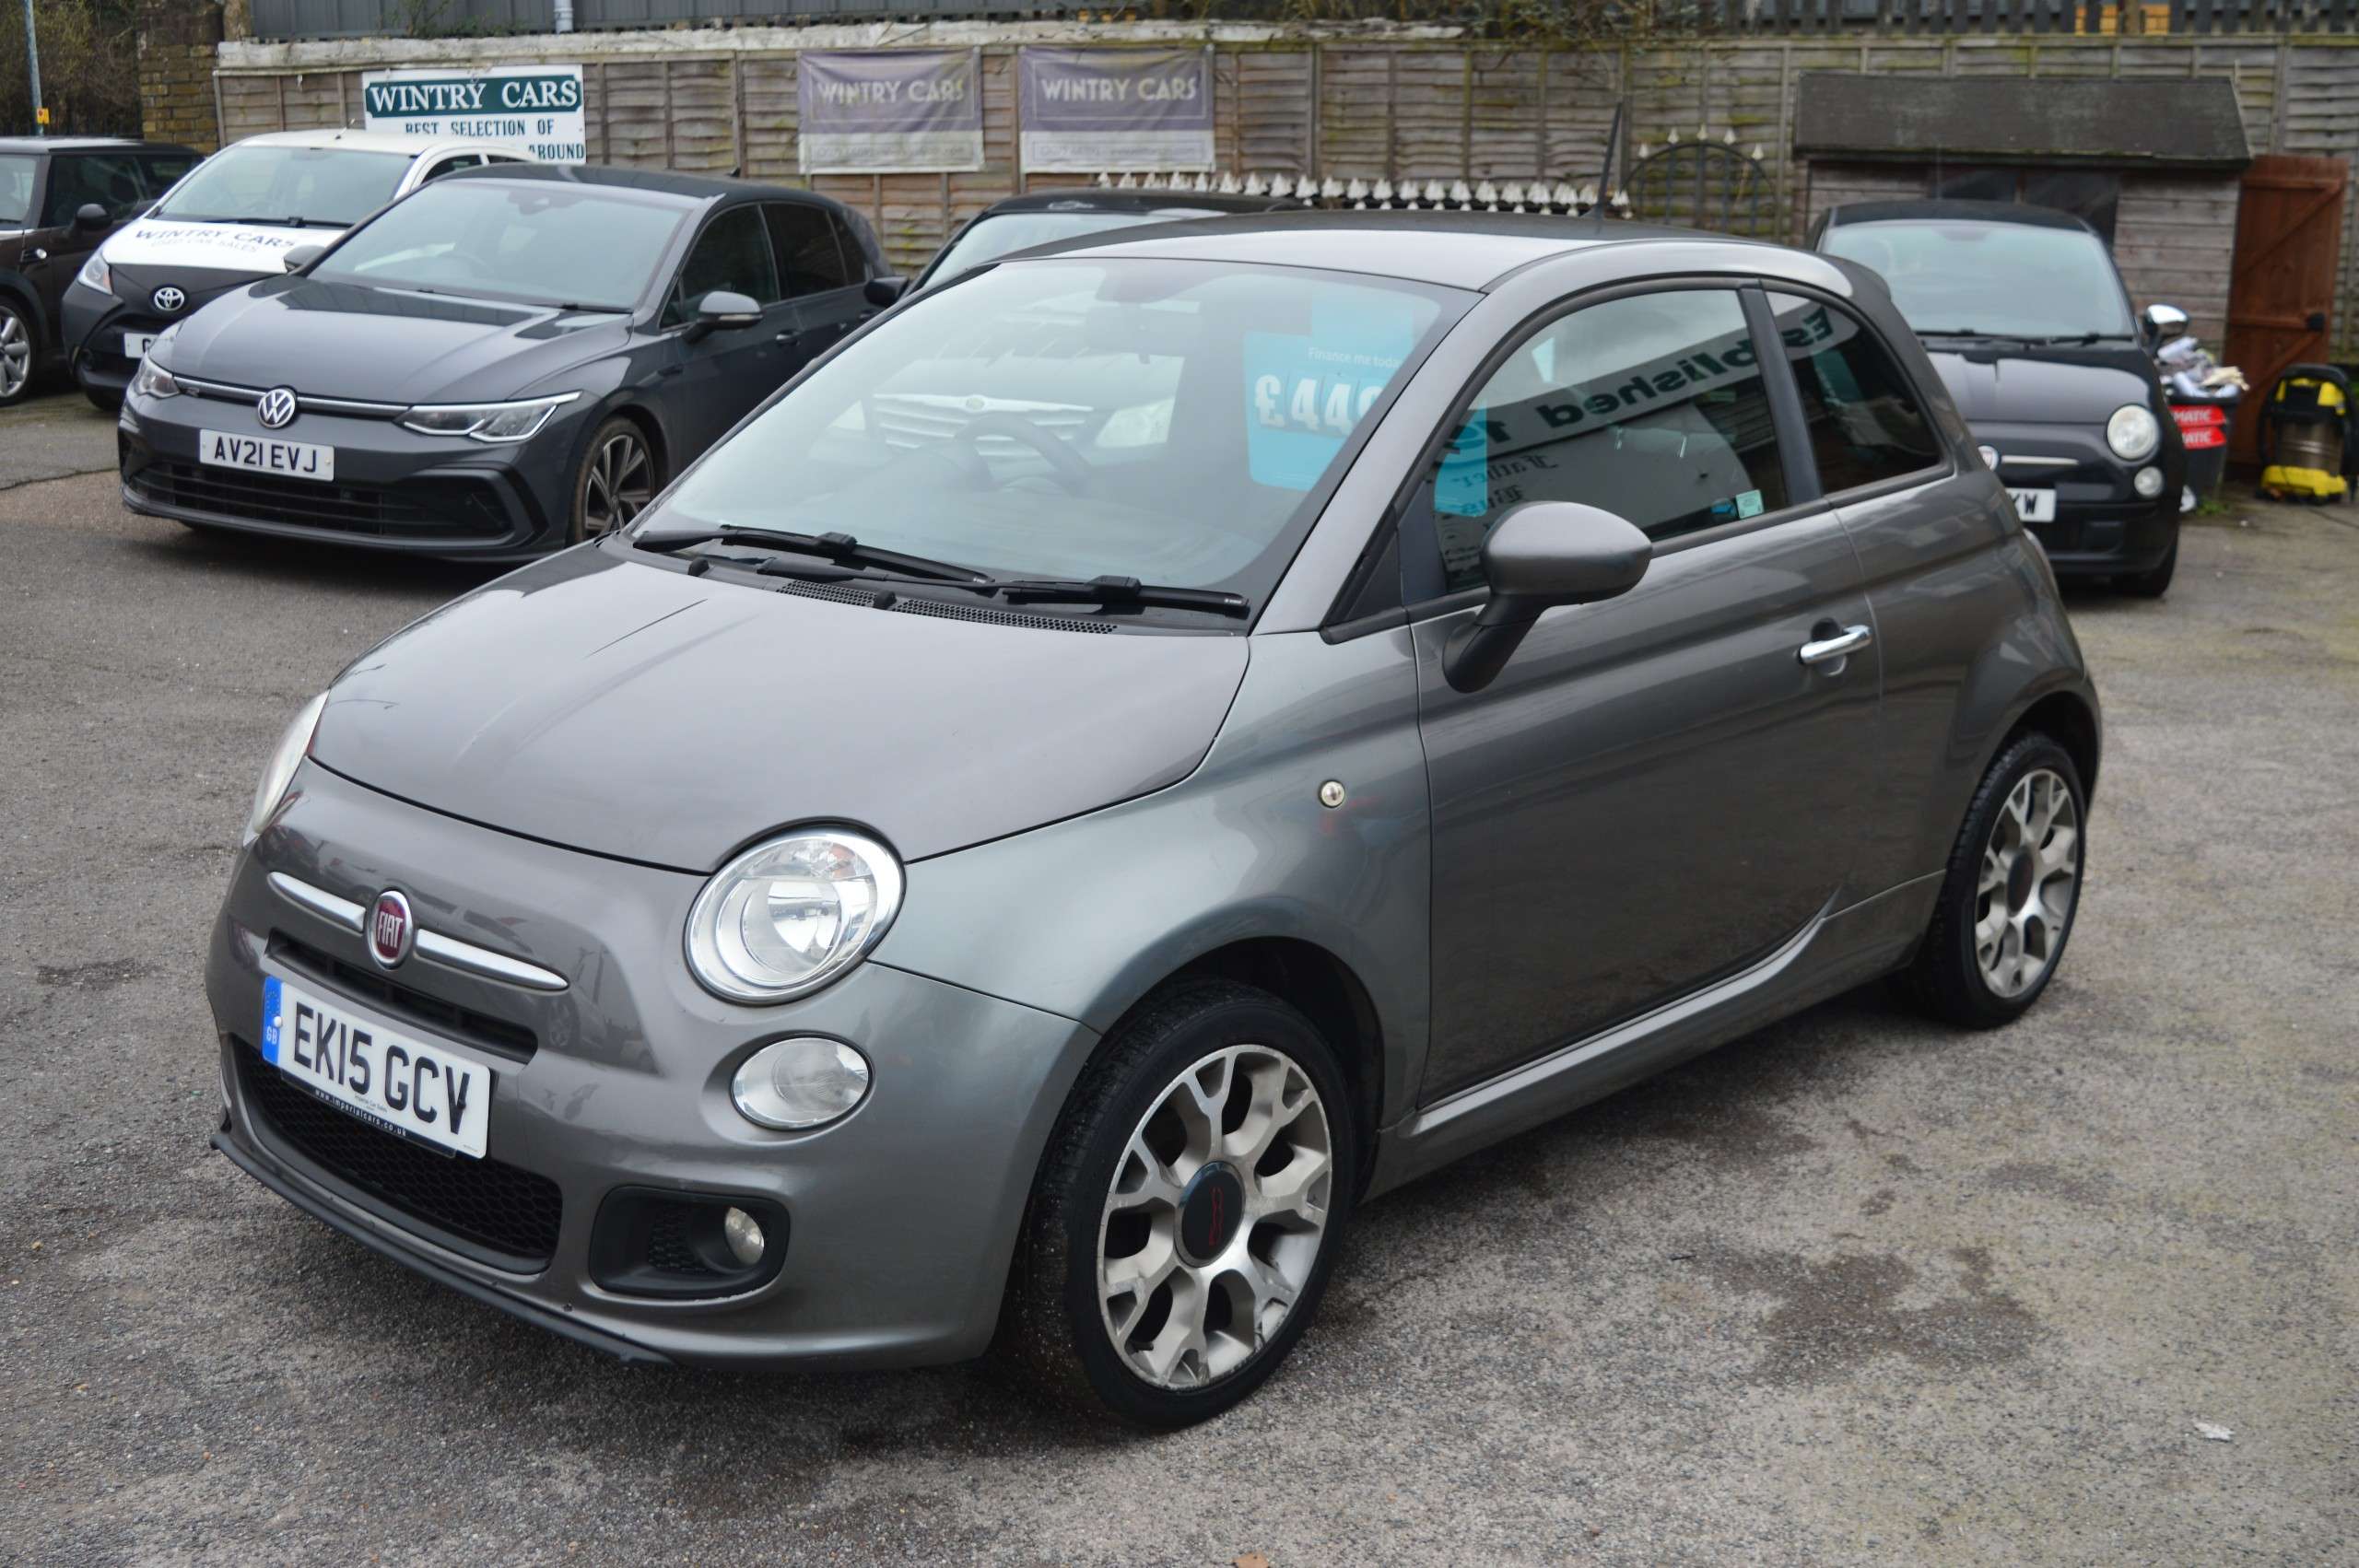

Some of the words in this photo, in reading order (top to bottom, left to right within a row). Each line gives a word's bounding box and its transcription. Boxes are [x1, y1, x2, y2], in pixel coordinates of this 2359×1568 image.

[370, 83, 487, 112] WINTRY
[501, 80, 578, 109] CARS
[816, 79, 901, 106] WINTRY
[908, 77, 964, 103] CARS
[1041, 78, 1129, 102] WINTRY
[1137, 76, 1196, 101] CARS
[451, 119, 525, 137] SELECTION
[537, 119, 555, 135] OF
[135, 228, 229, 240] WINTRY
[234, 231, 295, 247] CARS
[1373, 353, 1402, 369] toda
[214, 436, 263, 466] AV21
[271, 444, 317, 474] EVJ
[377, 910, 404, 948] FIAT
[266, 1025, 278, 1046] GB
[293, 1001, 373, 1096] EK15
[384, 1045, 471, 1136] GCV
